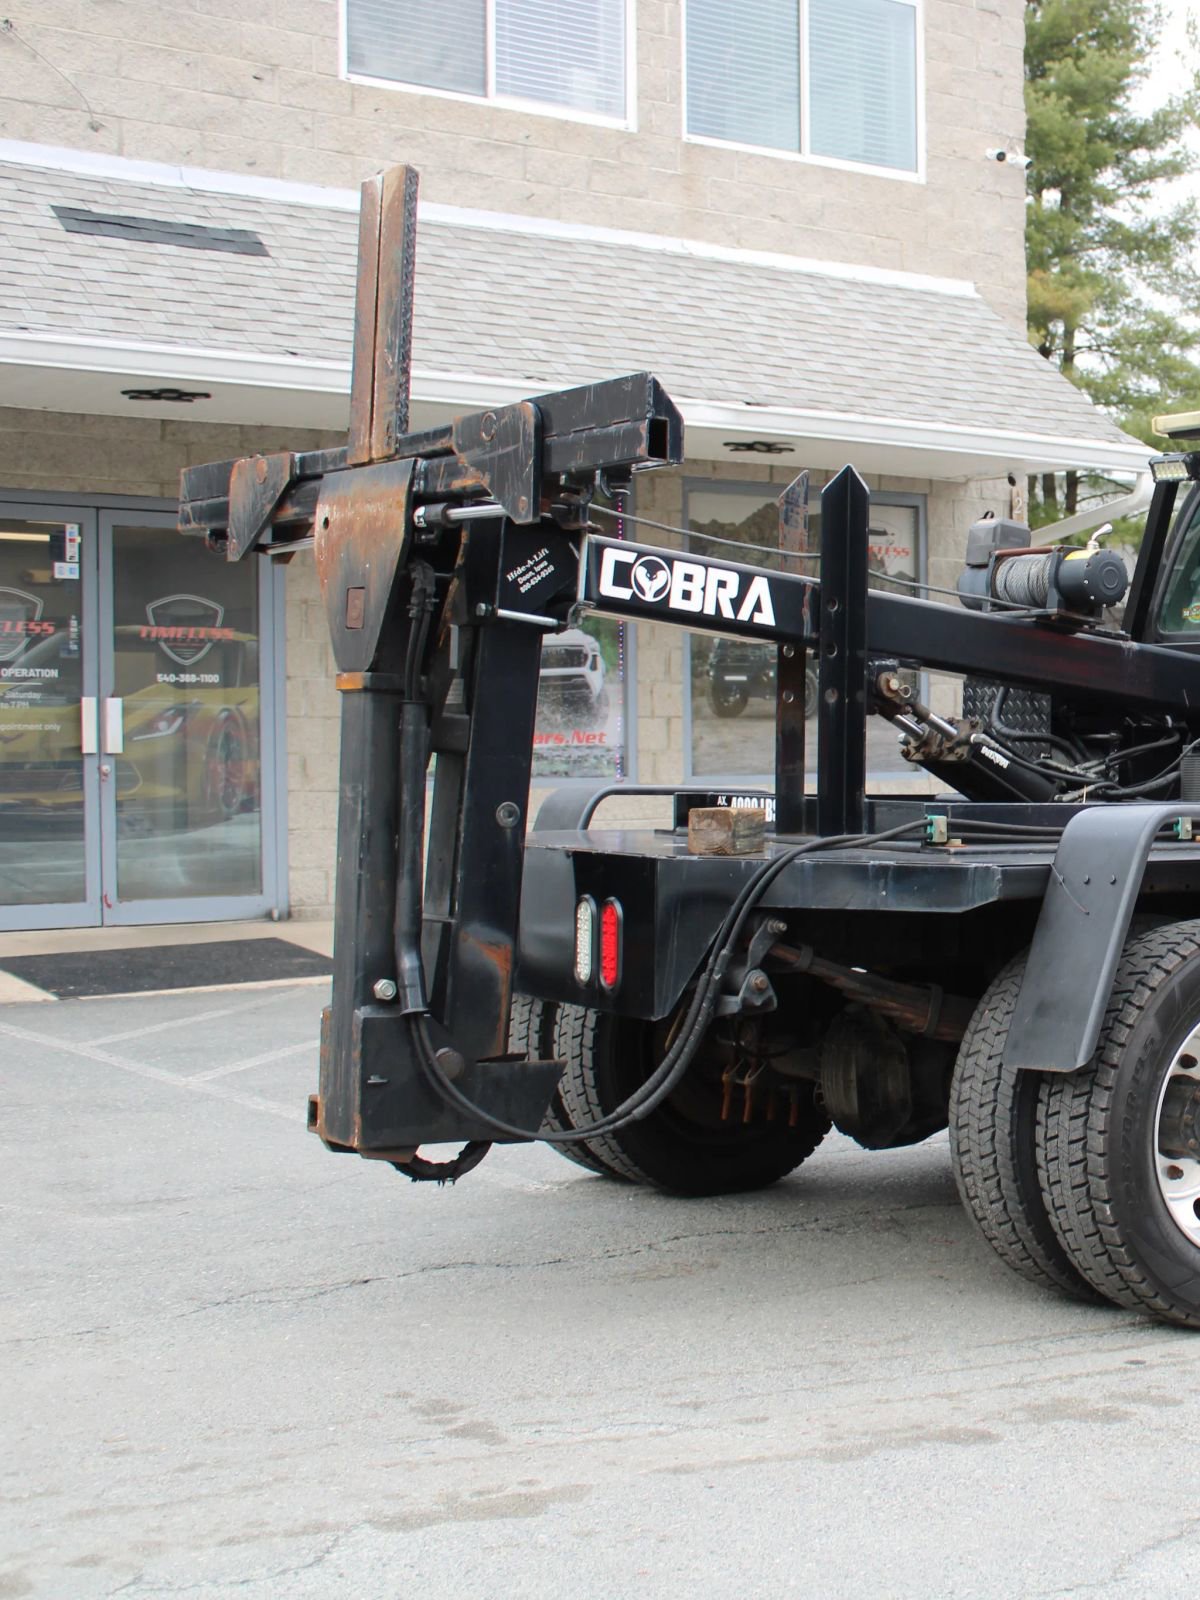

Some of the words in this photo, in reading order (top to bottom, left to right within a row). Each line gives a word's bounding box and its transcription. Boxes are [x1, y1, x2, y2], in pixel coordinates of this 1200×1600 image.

[506, 547, 550, 582] Hide-A-Lift
[599, 547, 776, 626] COBRA
[0, 667, 59, 679] OPERATION
[5, 690, 42, 700] Saturday
